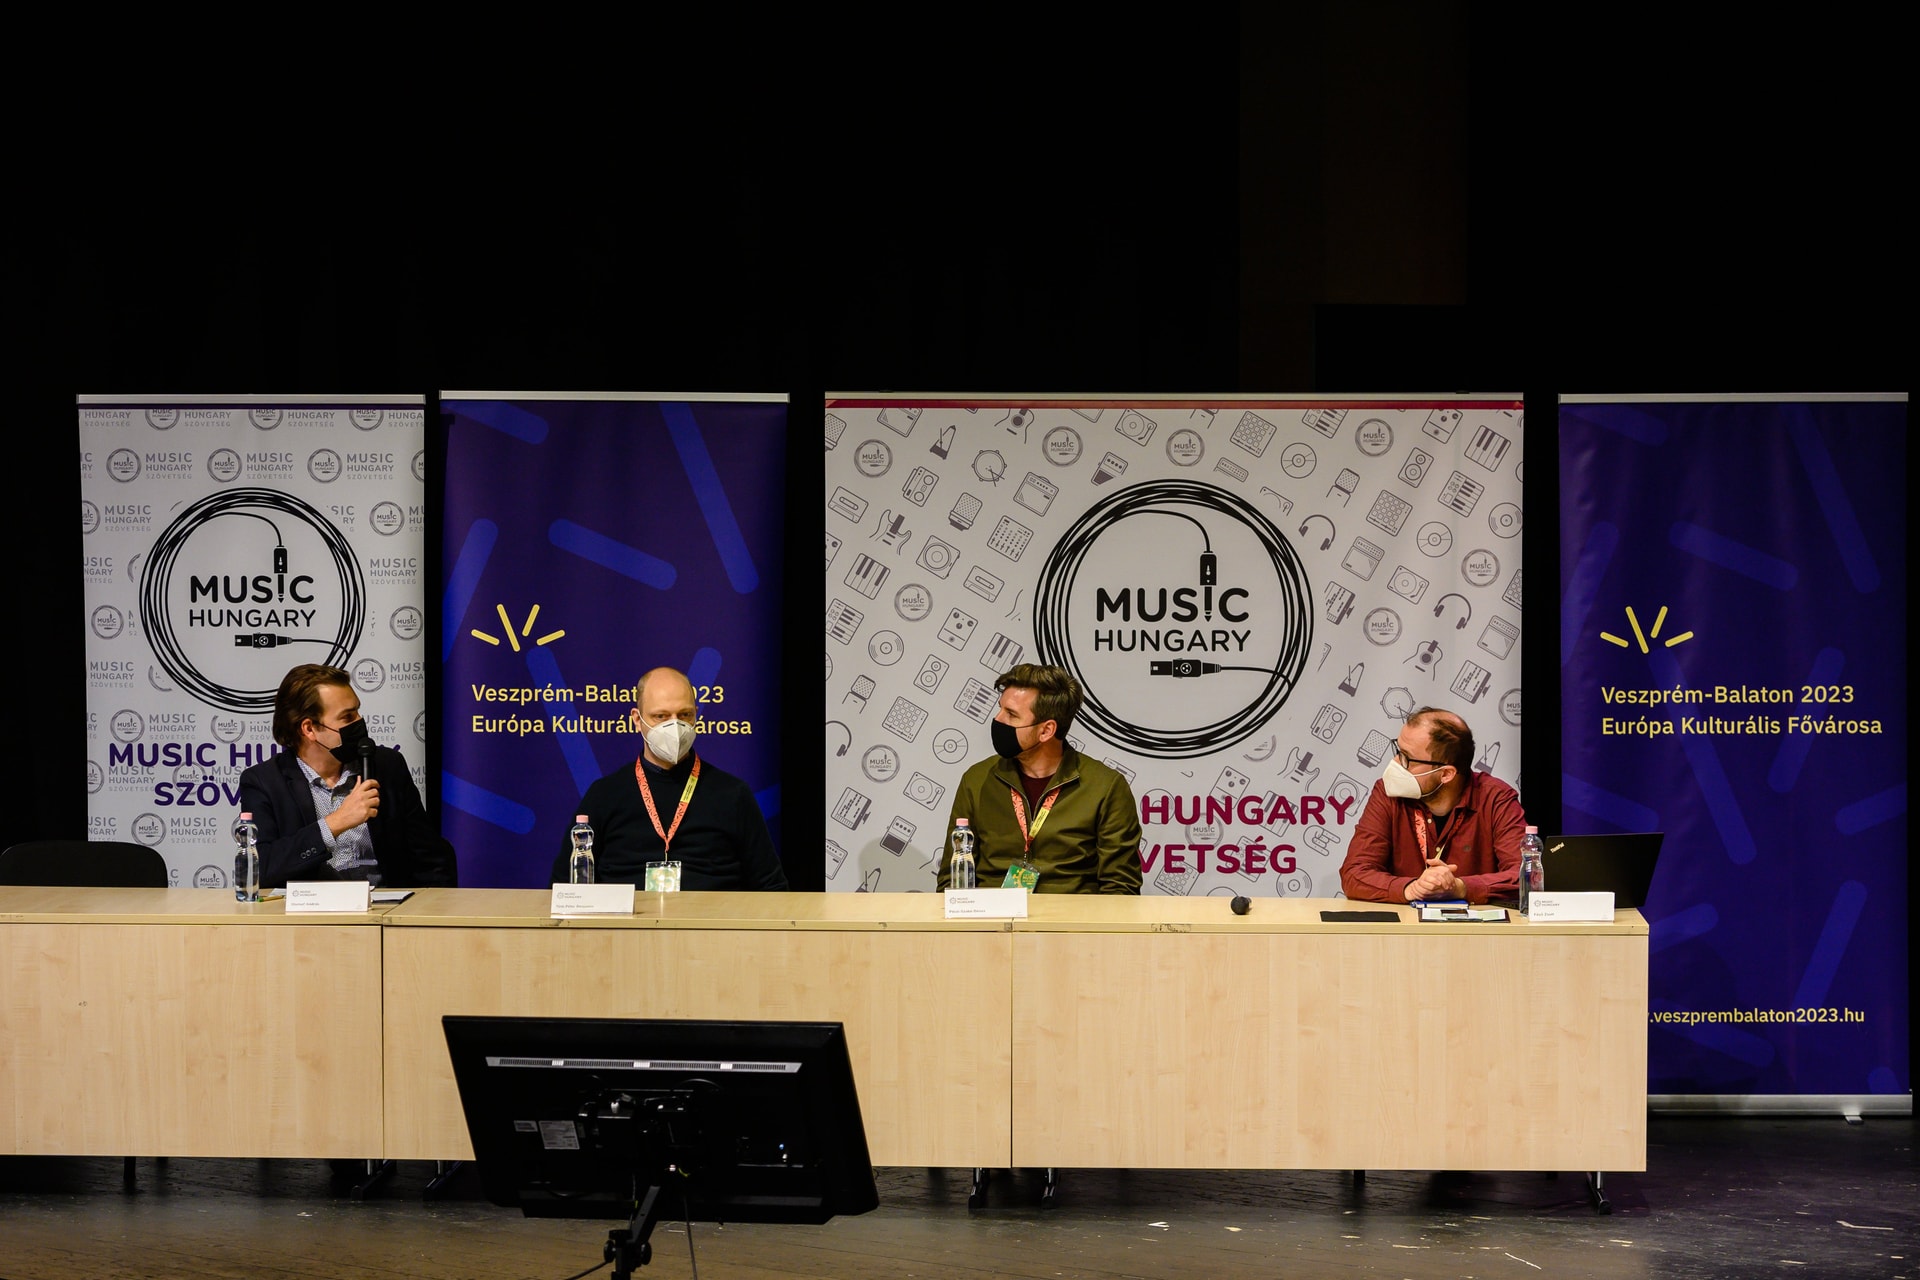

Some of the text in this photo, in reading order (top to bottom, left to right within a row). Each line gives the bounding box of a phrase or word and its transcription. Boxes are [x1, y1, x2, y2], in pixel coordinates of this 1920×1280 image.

[145, 453, 192, 463] MUSIC
[246, 453, 293, 463] MUSIC
[347, 454, 394, 463] MUSIC
[104, 505, 151, 515] MUSIC
[370, 558, 416, 568] MUSIC
[370, 569, 417, 577] HUNGARY
[190, 575, 315, 604] MUSIC
[1096, 587, 1249, 622] MUSIC
[189, 609, 316, 627] HUNGARY
[1094, 629, 1251, 652] HUNGARY
[90, 661, 134, 671] MUSIC
[1601, 684, 1854, 708] Veszprém-Balaton 2023
[149, 714, 195, 723] MUSIC
[472, 713, 545, 737] Európa
[1602, 714, 1883, 739] Európa Kulturális Fővárosa
[109, 743, 216, 767] MUSIC
[1141, 795, 1354, 825] HUNGARY
[170, 817, 217, 827] MUSIC
[170, 828, 217, 836] HUNGARY
